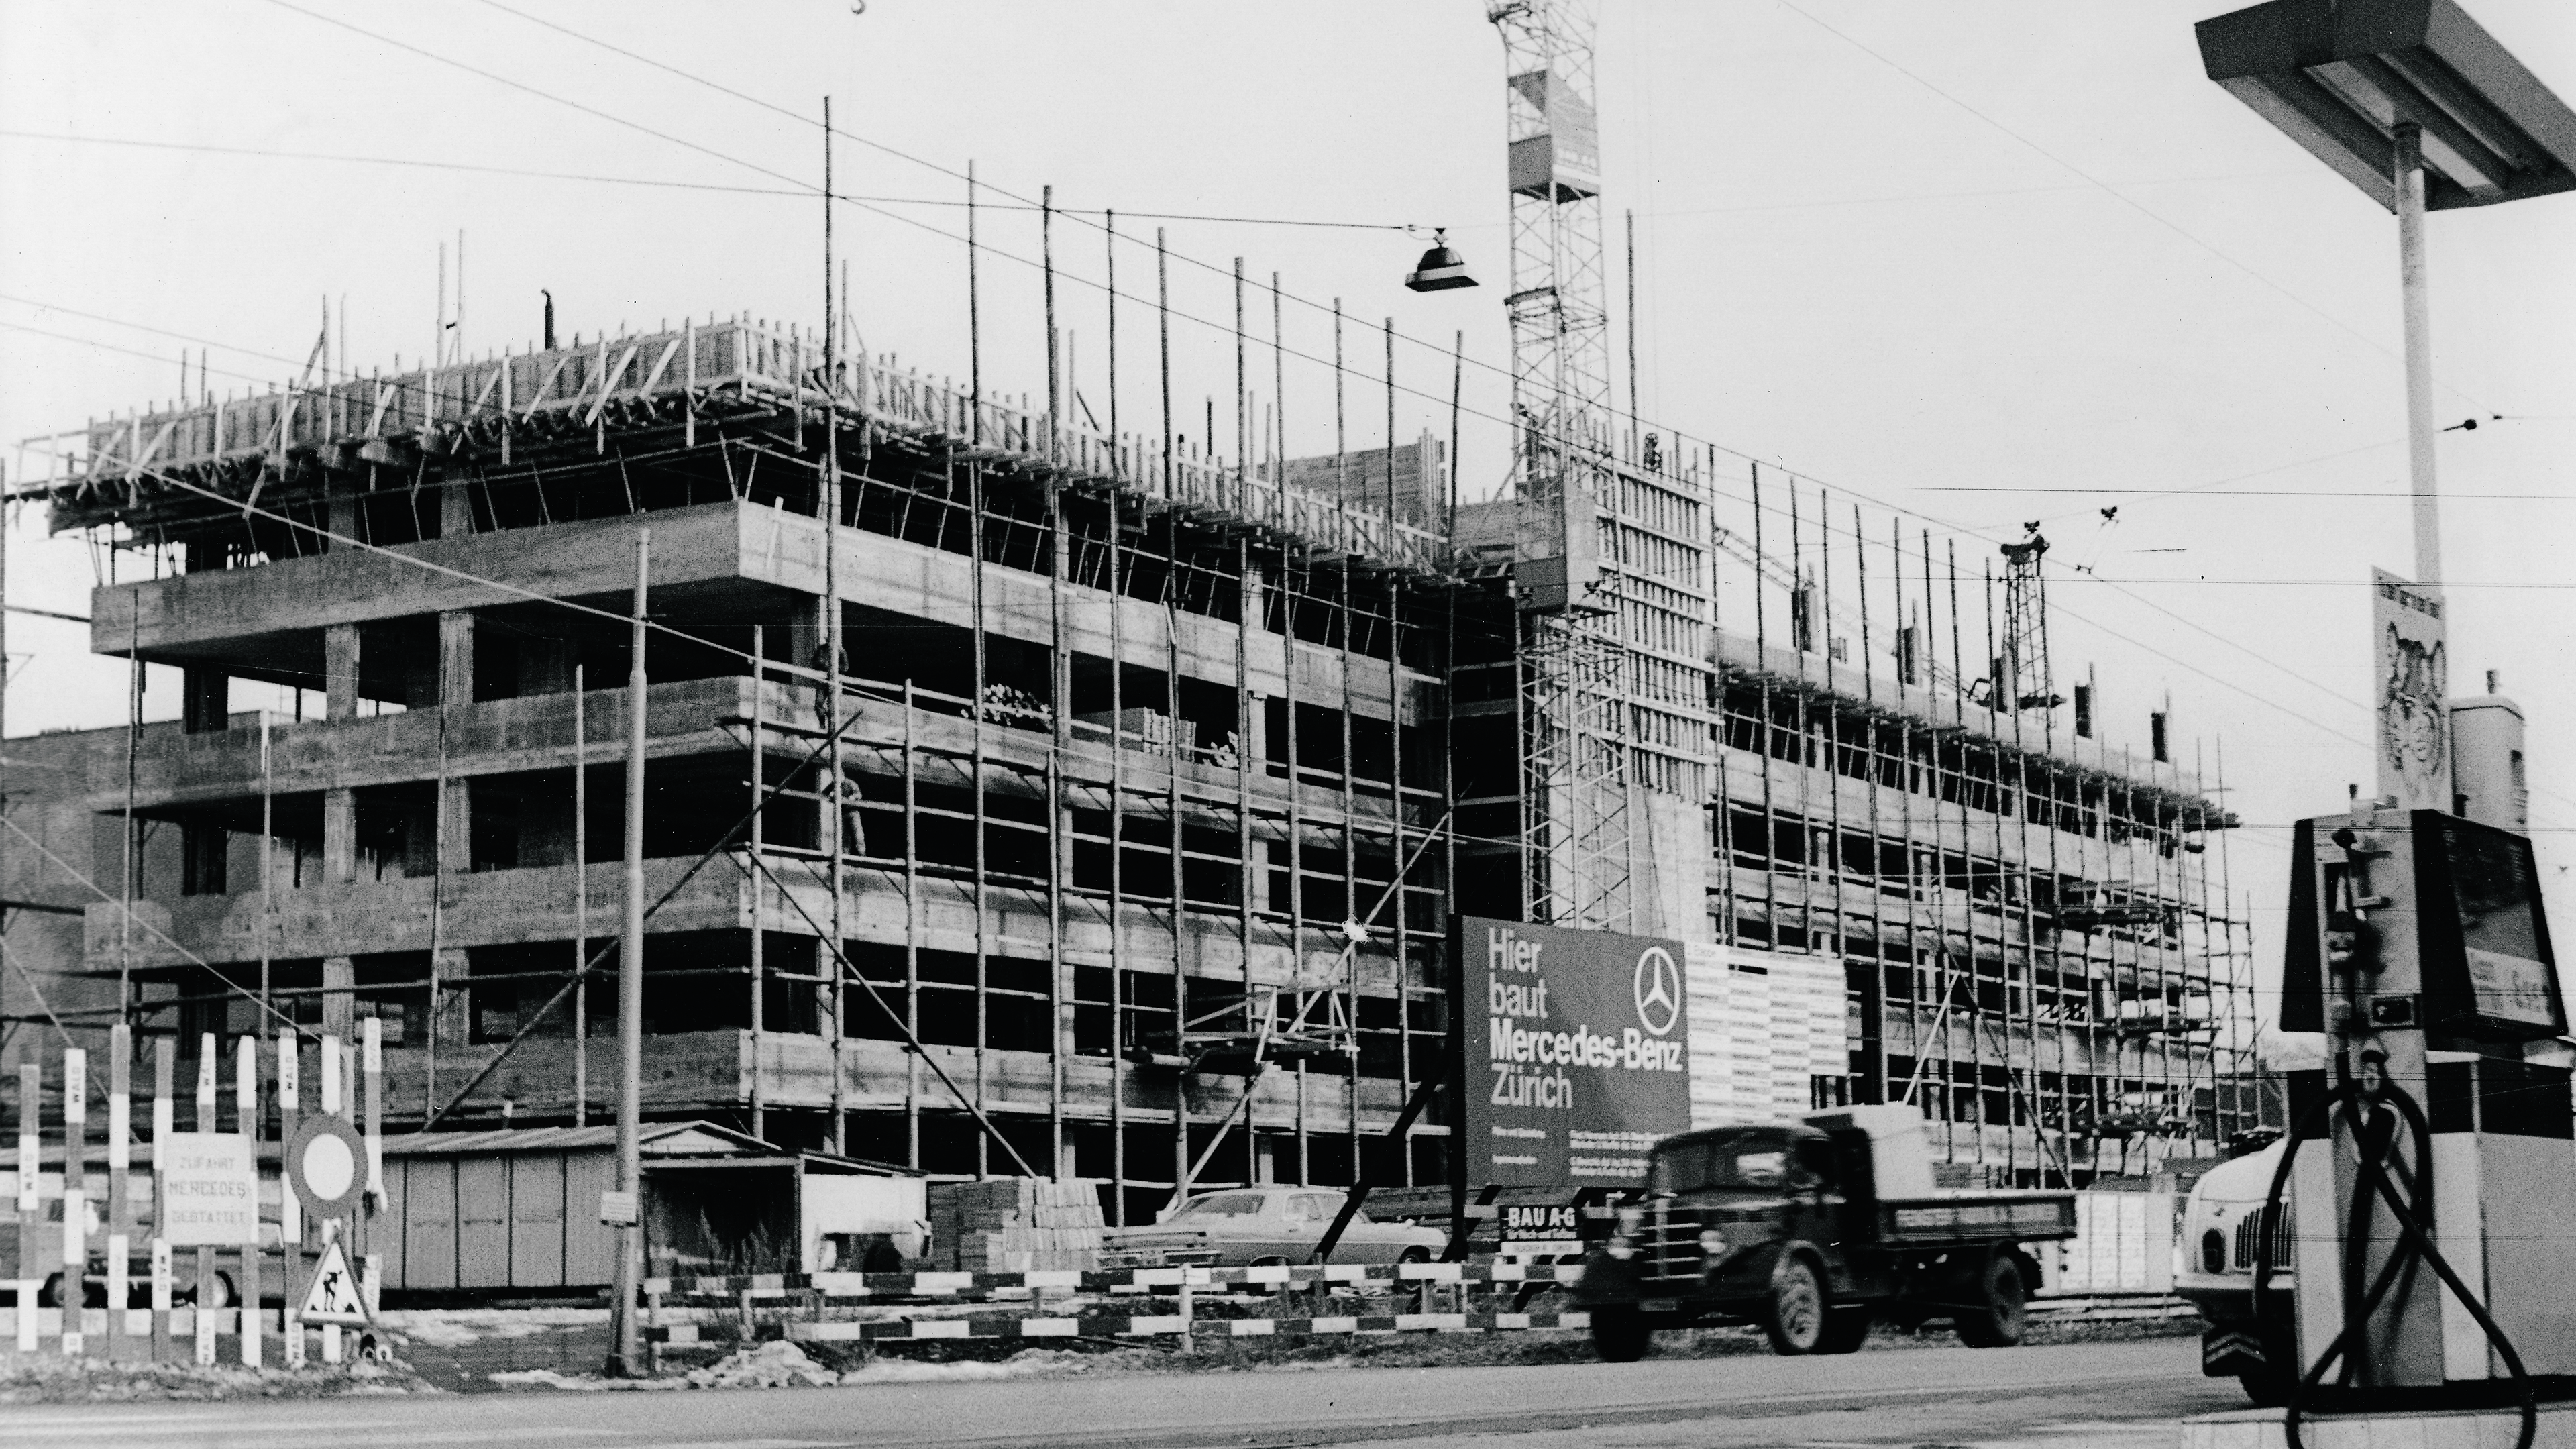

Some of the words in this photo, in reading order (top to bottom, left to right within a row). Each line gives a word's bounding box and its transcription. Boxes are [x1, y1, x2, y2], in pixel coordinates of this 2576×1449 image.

[1489, 926, 1542, 973] Hier
[1489, 972, 1548, 1019] baut
[1490, 1016, 1683, 1072] Mercedes-Benz
[1491, 1062, 1573, 1108] Zürich
[168, 1180, 246, 1196] MERCEDES
[1508, 1207, 1545, 1228] BAU
